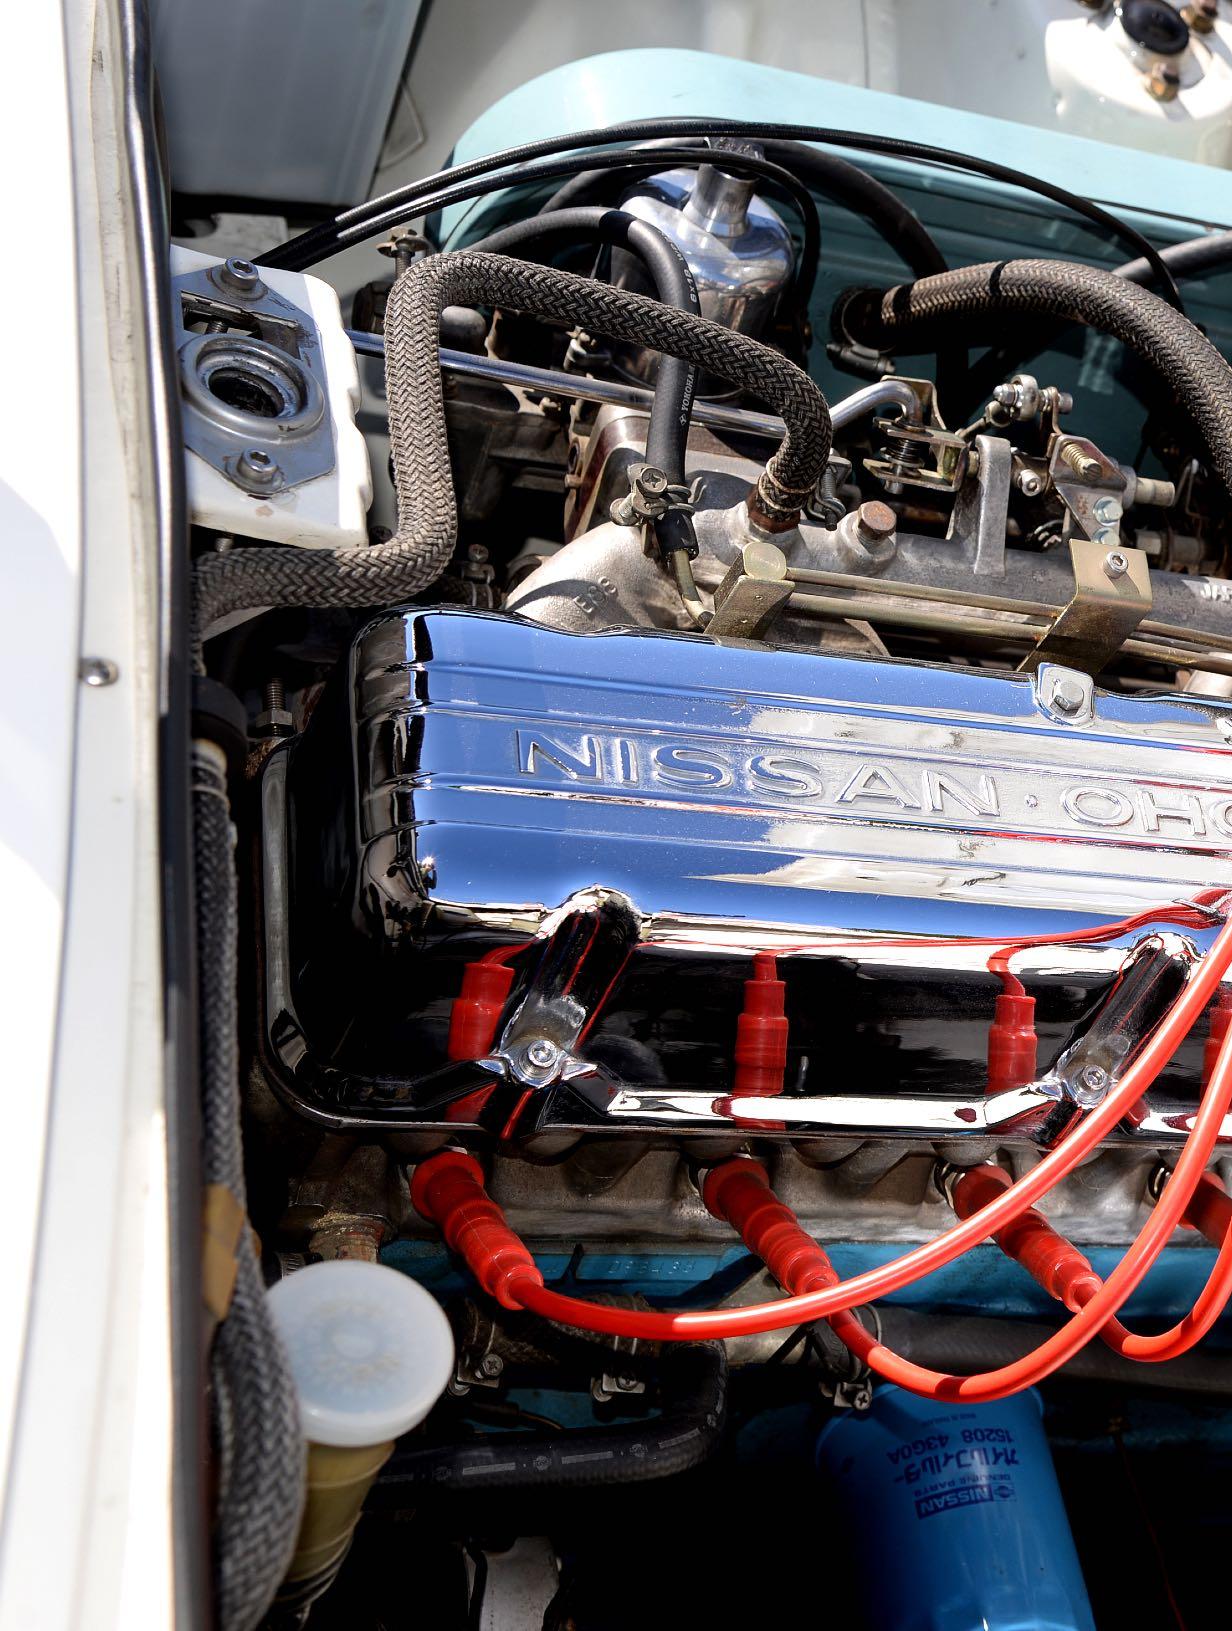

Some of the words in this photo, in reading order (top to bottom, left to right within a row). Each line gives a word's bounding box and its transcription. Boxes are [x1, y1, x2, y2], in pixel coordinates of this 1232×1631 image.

[516, 729, 1001, 816] NISSAN
[961, 1428, 1014, 1443] 15208
[894, 1446, 1020, 1485] オイルフィルター
[913, 1480, 957, 1498] PARTS
[918, 1487, 992, 1517] NISSAN
